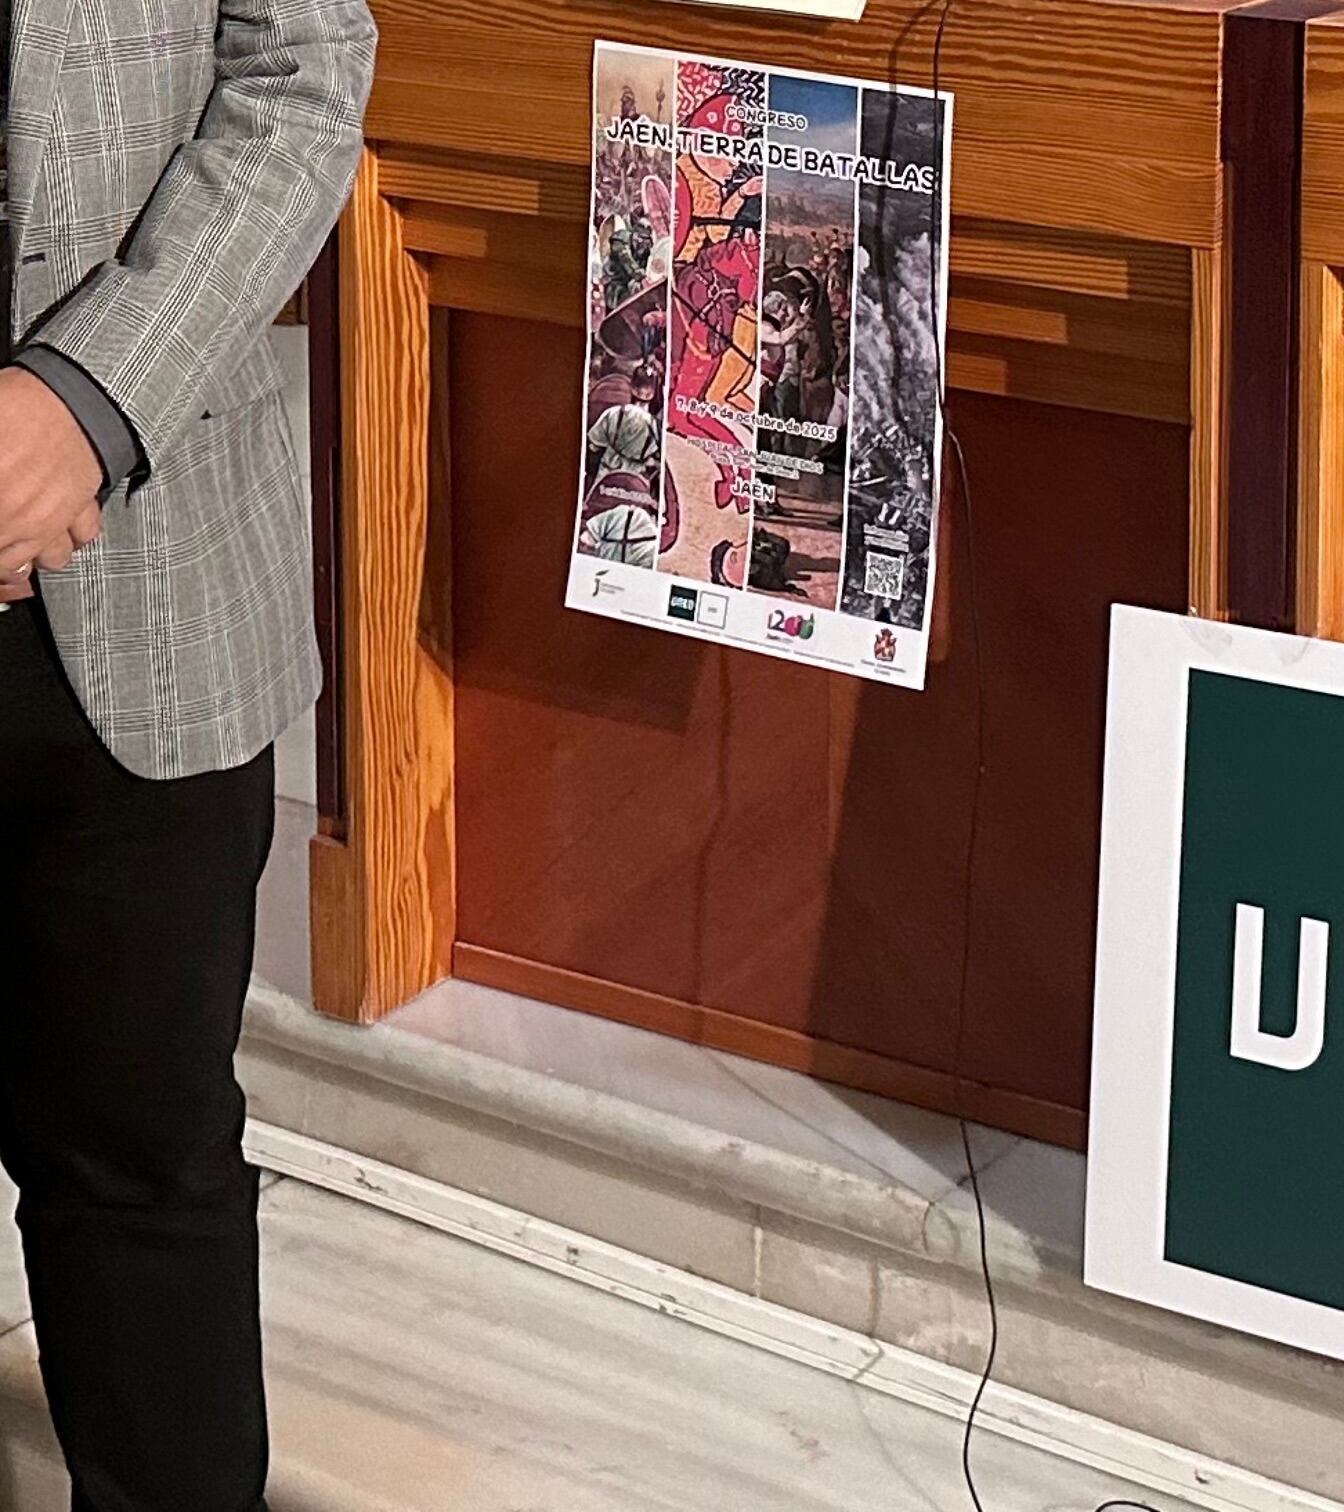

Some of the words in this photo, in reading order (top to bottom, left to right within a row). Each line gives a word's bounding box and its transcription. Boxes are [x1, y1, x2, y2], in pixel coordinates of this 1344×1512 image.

[725, 105, 806, 130] CONGRESO
[678, 130, 763, 162] TIERRA
[768, 145, 798, 168] DE
[804, 151, 936, 191] BATALLAS
[720, 408, 734, 419] de
[736, 413, 783, 430] octubre
[785, 420, 801, 433] de
[802, 422, 836, 440] 2025
[731, 478, 774, 500] JAÉN
